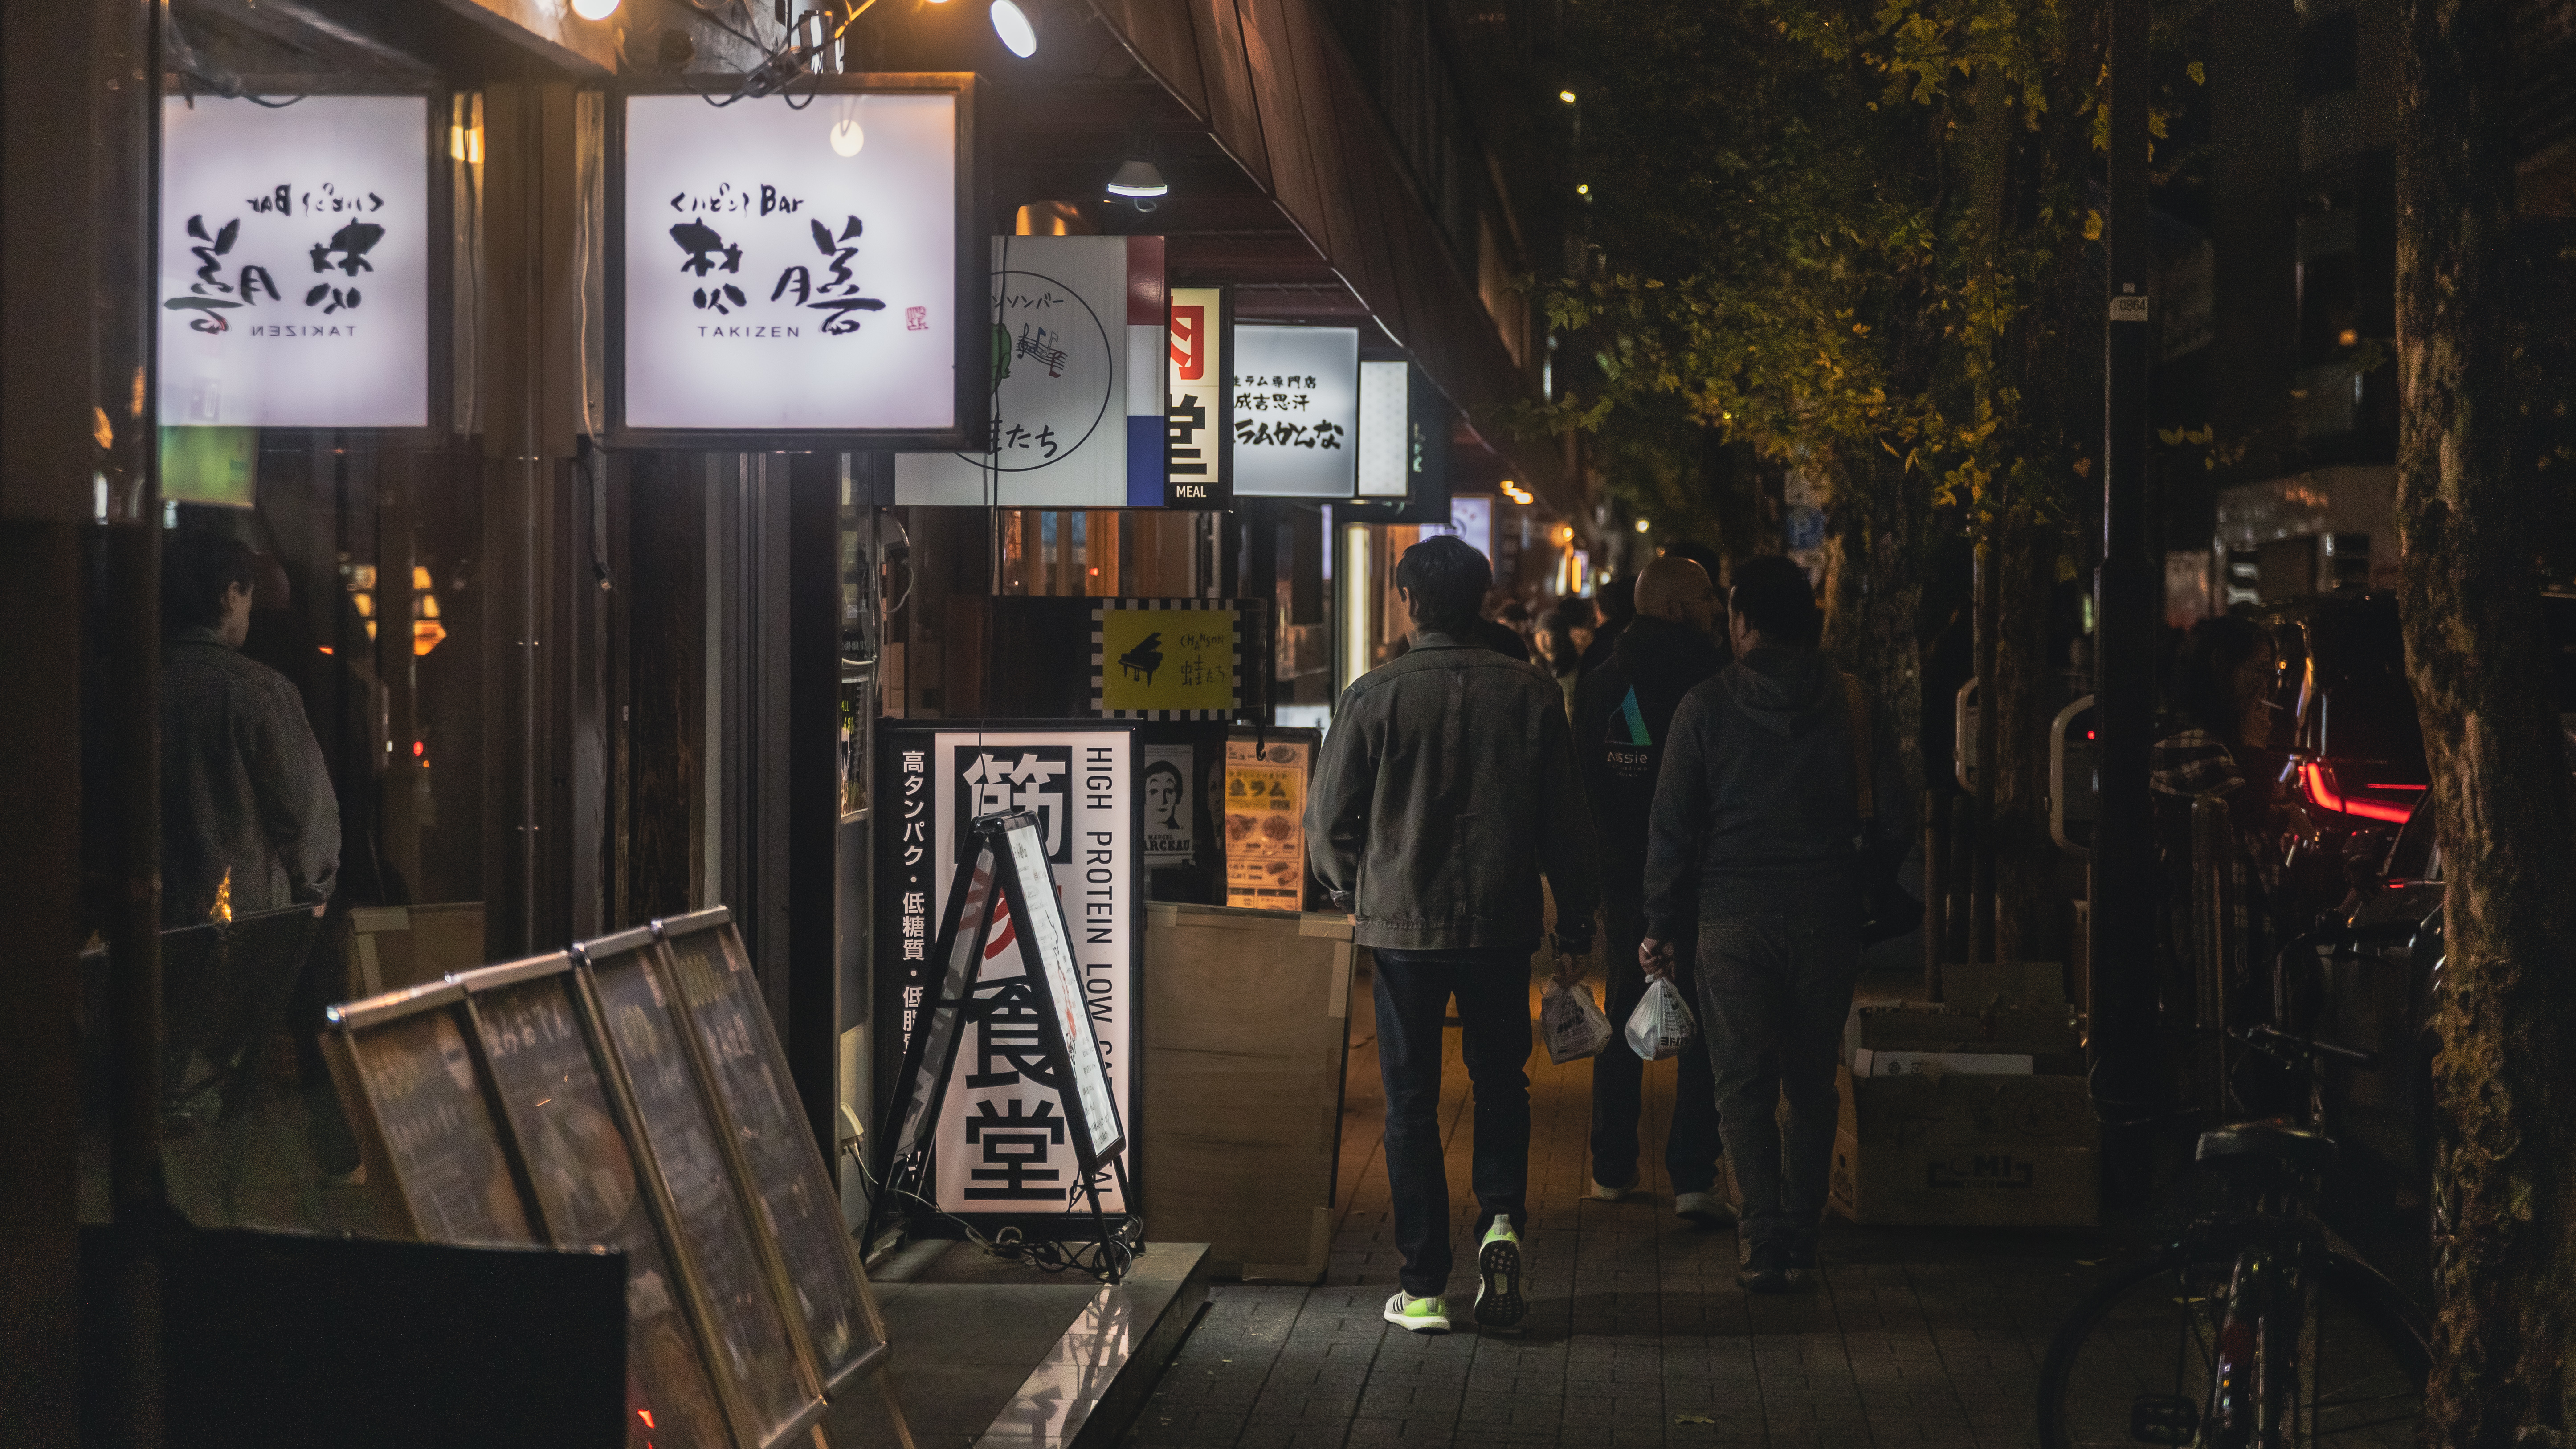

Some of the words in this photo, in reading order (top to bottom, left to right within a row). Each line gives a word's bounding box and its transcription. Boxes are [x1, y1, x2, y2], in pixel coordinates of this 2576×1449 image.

[761, 183, 804, 216] Bar
[2120, 298, 2145, 310] 0864
[698, 326, 800, 337] TAKIZEN
[1234, 392, 1310, 412] 成吉思汗
[1176, 486, 1206, 498] MEAL
[1086, 747, 1113, 810] HIGH
[1086, 831, 1113, 944] PROTEIN
[963, 754, 1067, 1201] 筋食堂
[1086, 964, 1113, 1023] LOW
